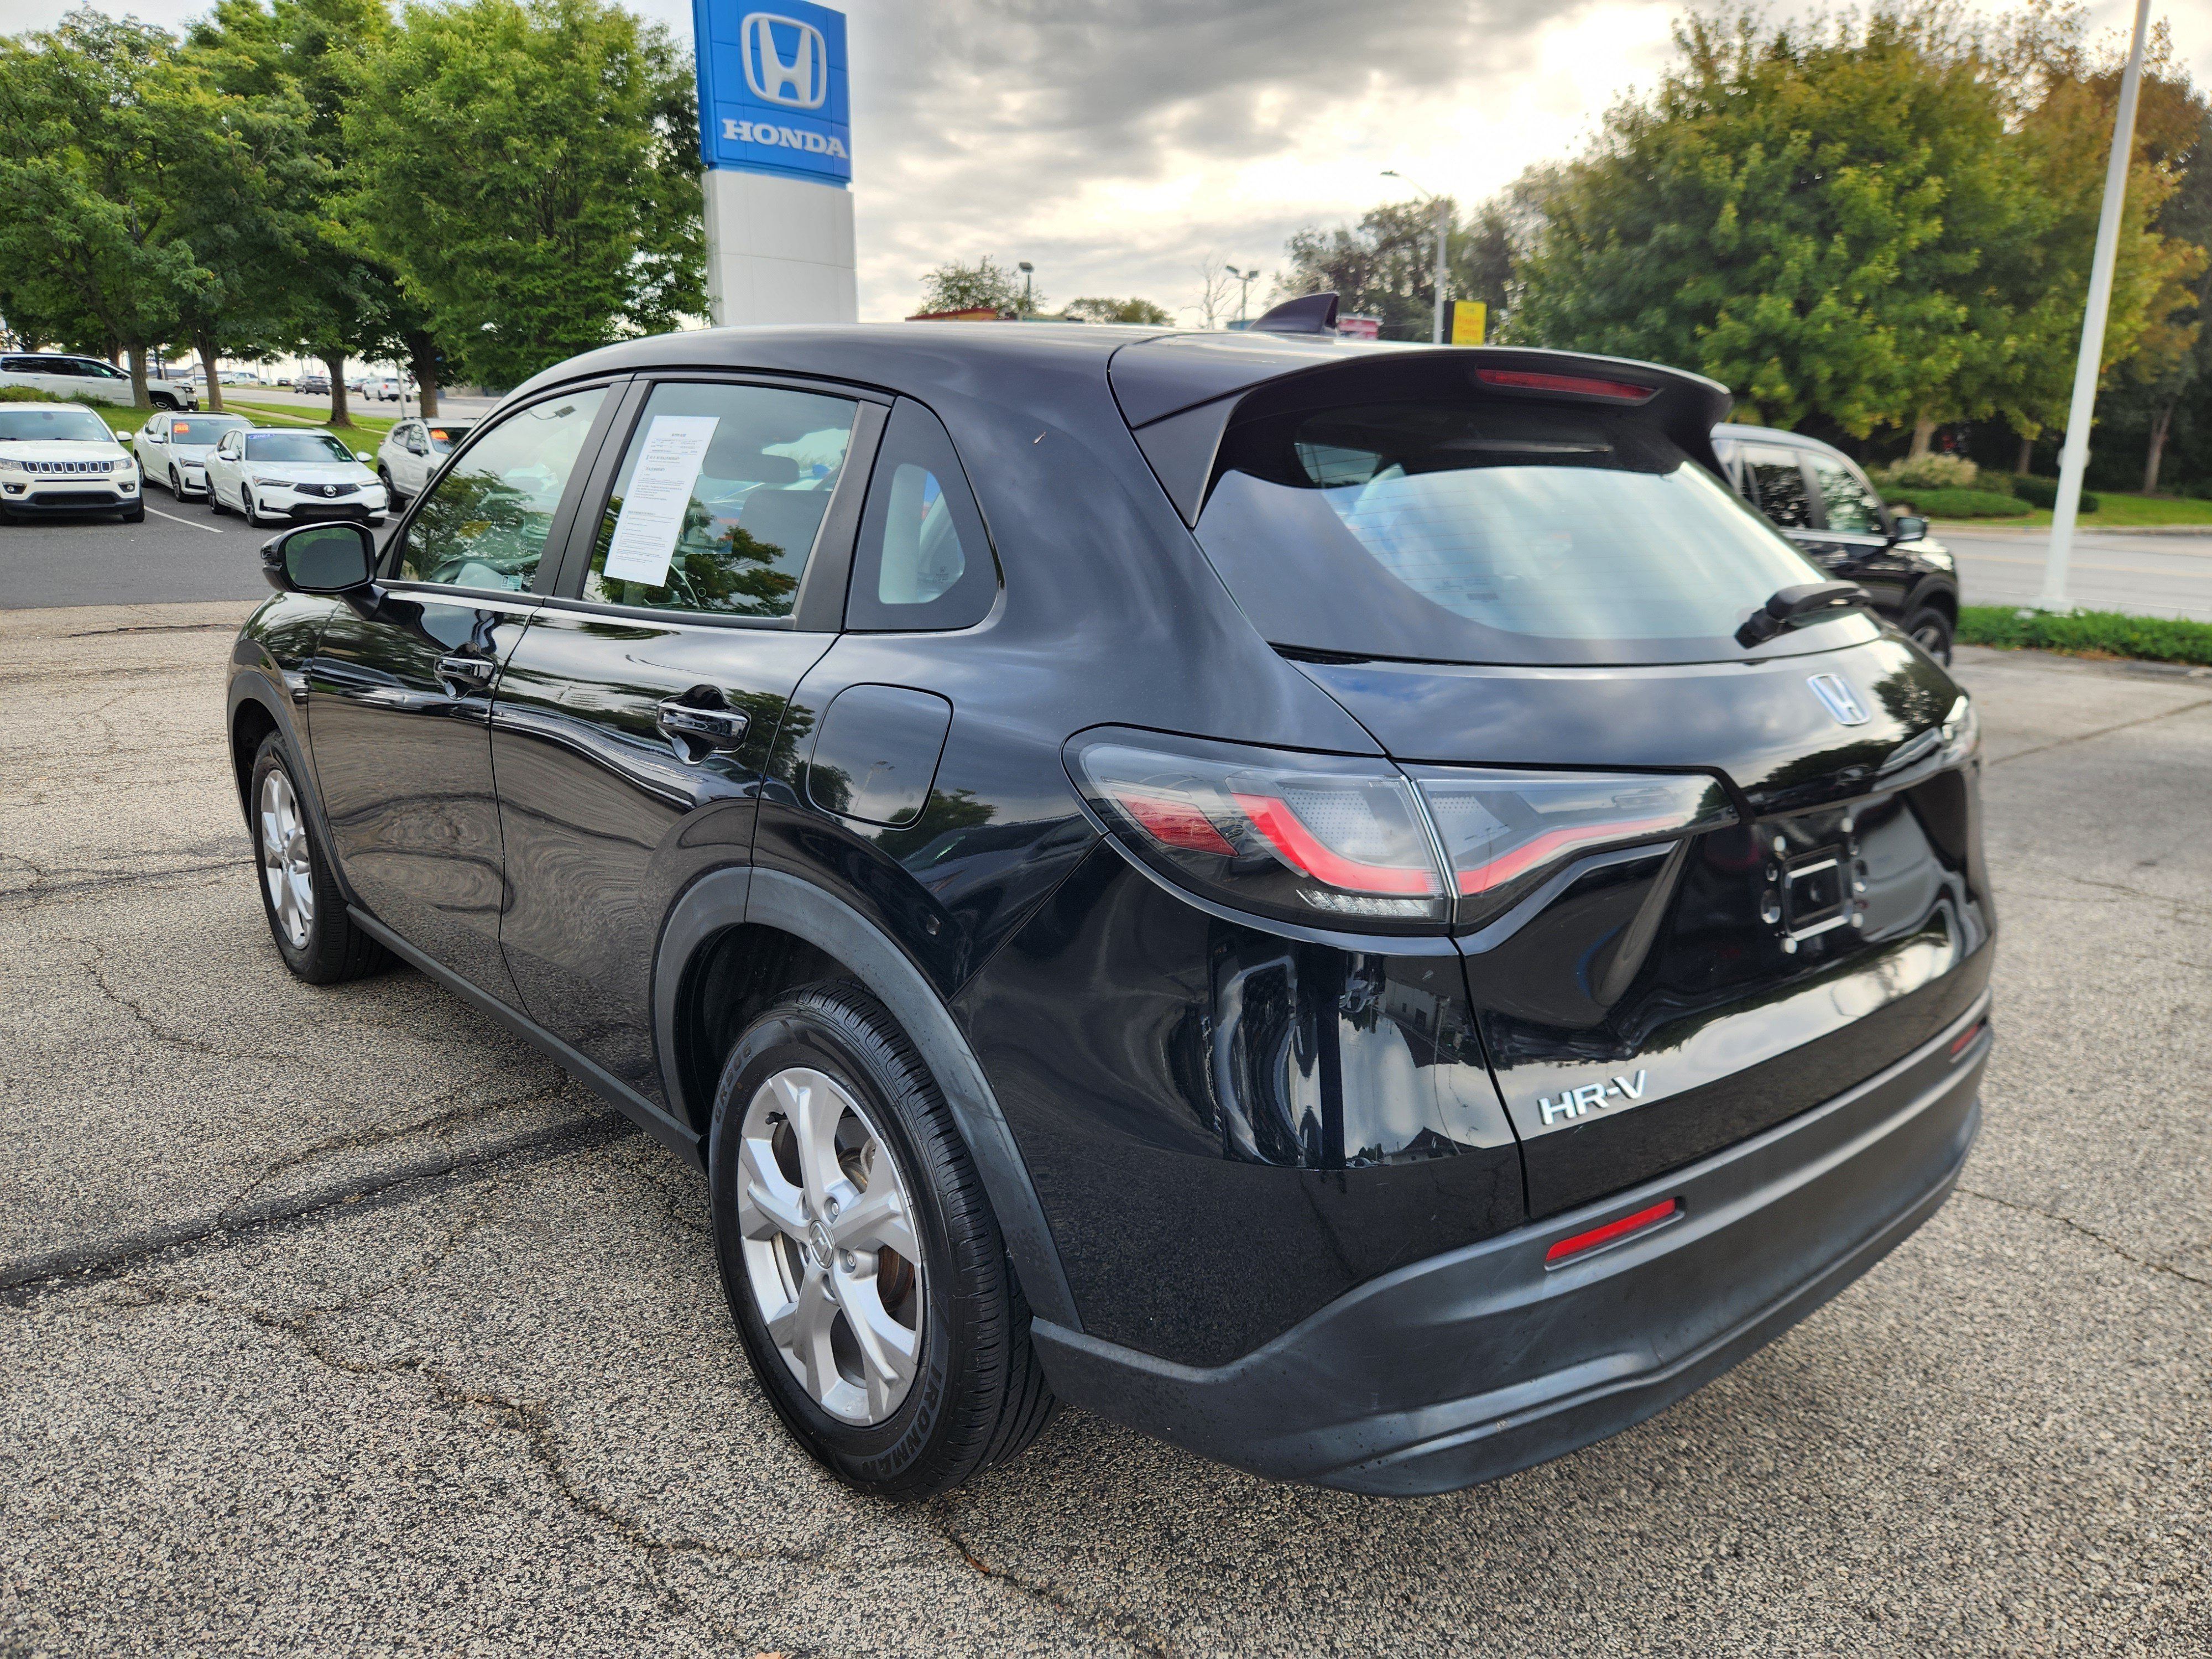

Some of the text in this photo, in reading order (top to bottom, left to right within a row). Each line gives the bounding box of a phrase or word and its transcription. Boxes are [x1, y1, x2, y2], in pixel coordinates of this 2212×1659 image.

[722, 118, 848, 159] HONDA
[1538, 1069, 1646, 1125] HR-V
[862, 1362, 943, 1475] IRONMAN
